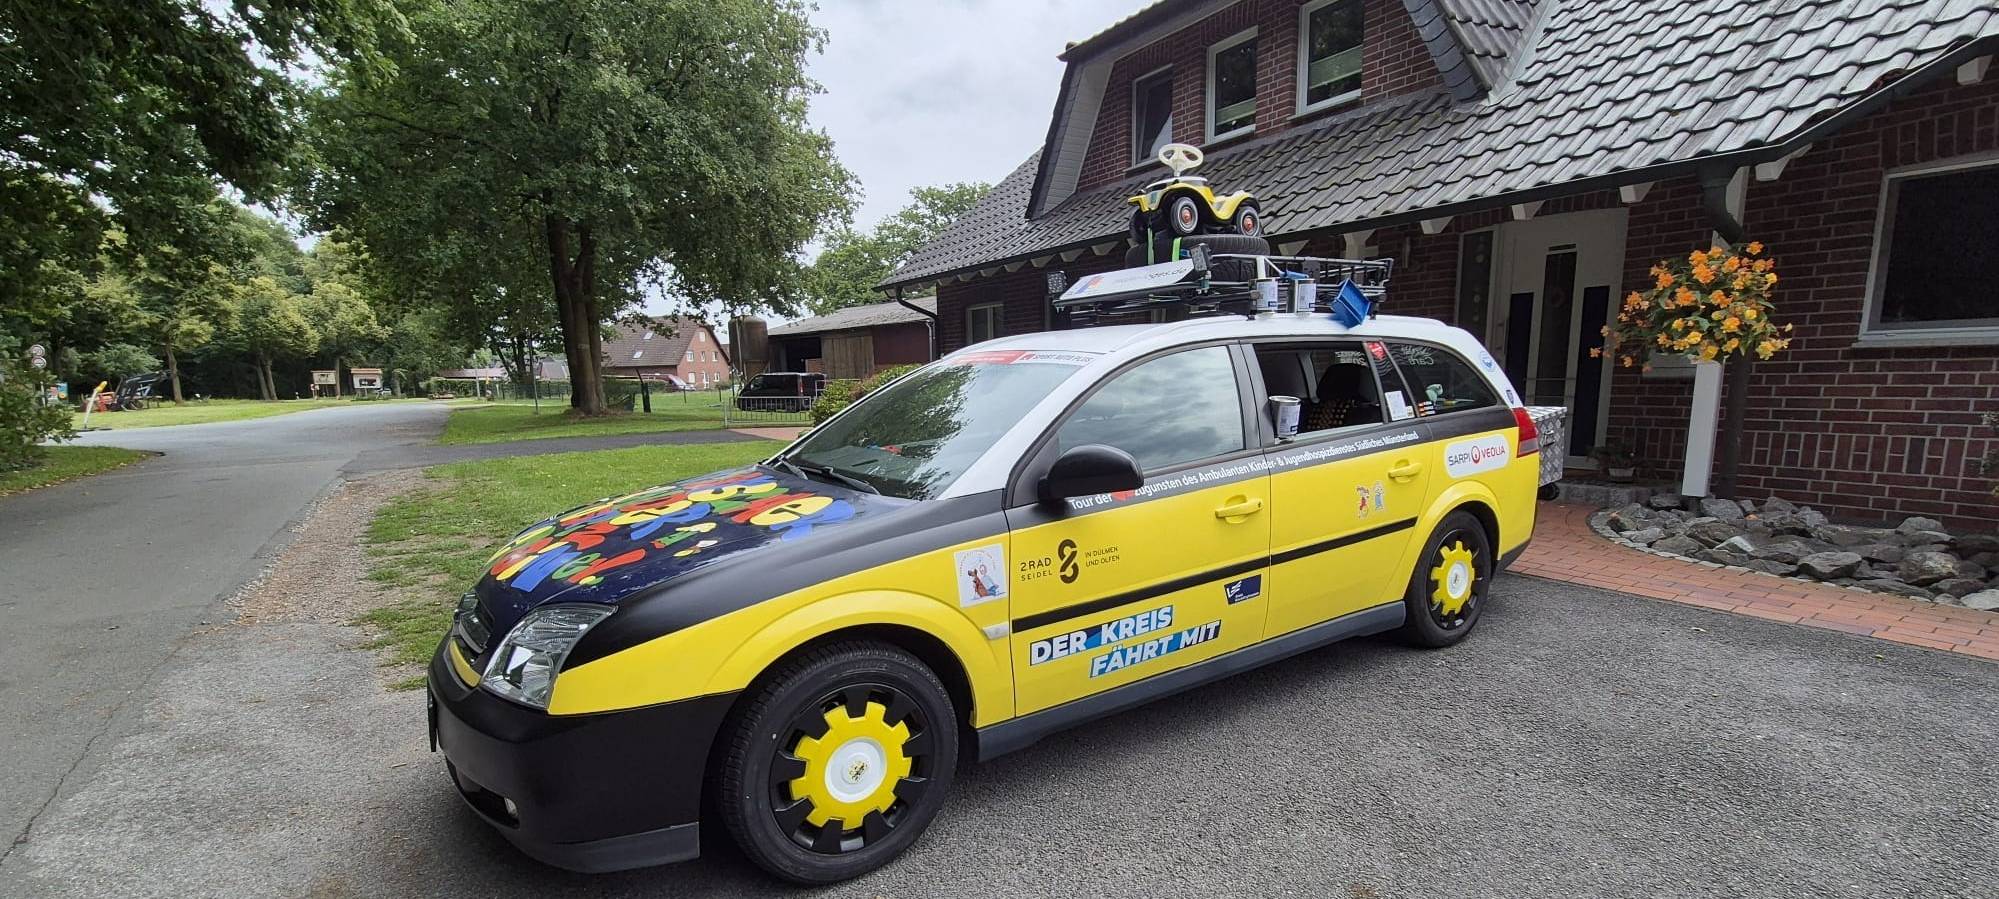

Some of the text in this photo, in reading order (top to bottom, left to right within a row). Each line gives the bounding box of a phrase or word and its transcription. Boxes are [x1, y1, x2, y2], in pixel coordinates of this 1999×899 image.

[1448, 446, 1506, 466] SARPI VEOLIA
[1067, 497, 1093, 510] Tour
[1095, 493, 1113, 505] der
[1183, 474, 1199, 486] des
[1199, 464, 1250, 482] Ambulanten
[1248, 457, 1277, 472] Kinder-
[1277, 456, 1285, 466] &
[1284, 443, 1356, 466] Jugendhospizdienstes
[1355, 437, 1385, 450] Südliches
[1383, 430, 1420, 446] Münsterland
[1020, 557, 1052, 572] 2RAD
[1085, 555, 1120, 567] UND OLFEN
[1021, 569, 1053, 581] SEIDEL
[1030, 606, 1173, 666] DER KREIS
[1091, 620, 1222, 678] FÄHRT MIT
